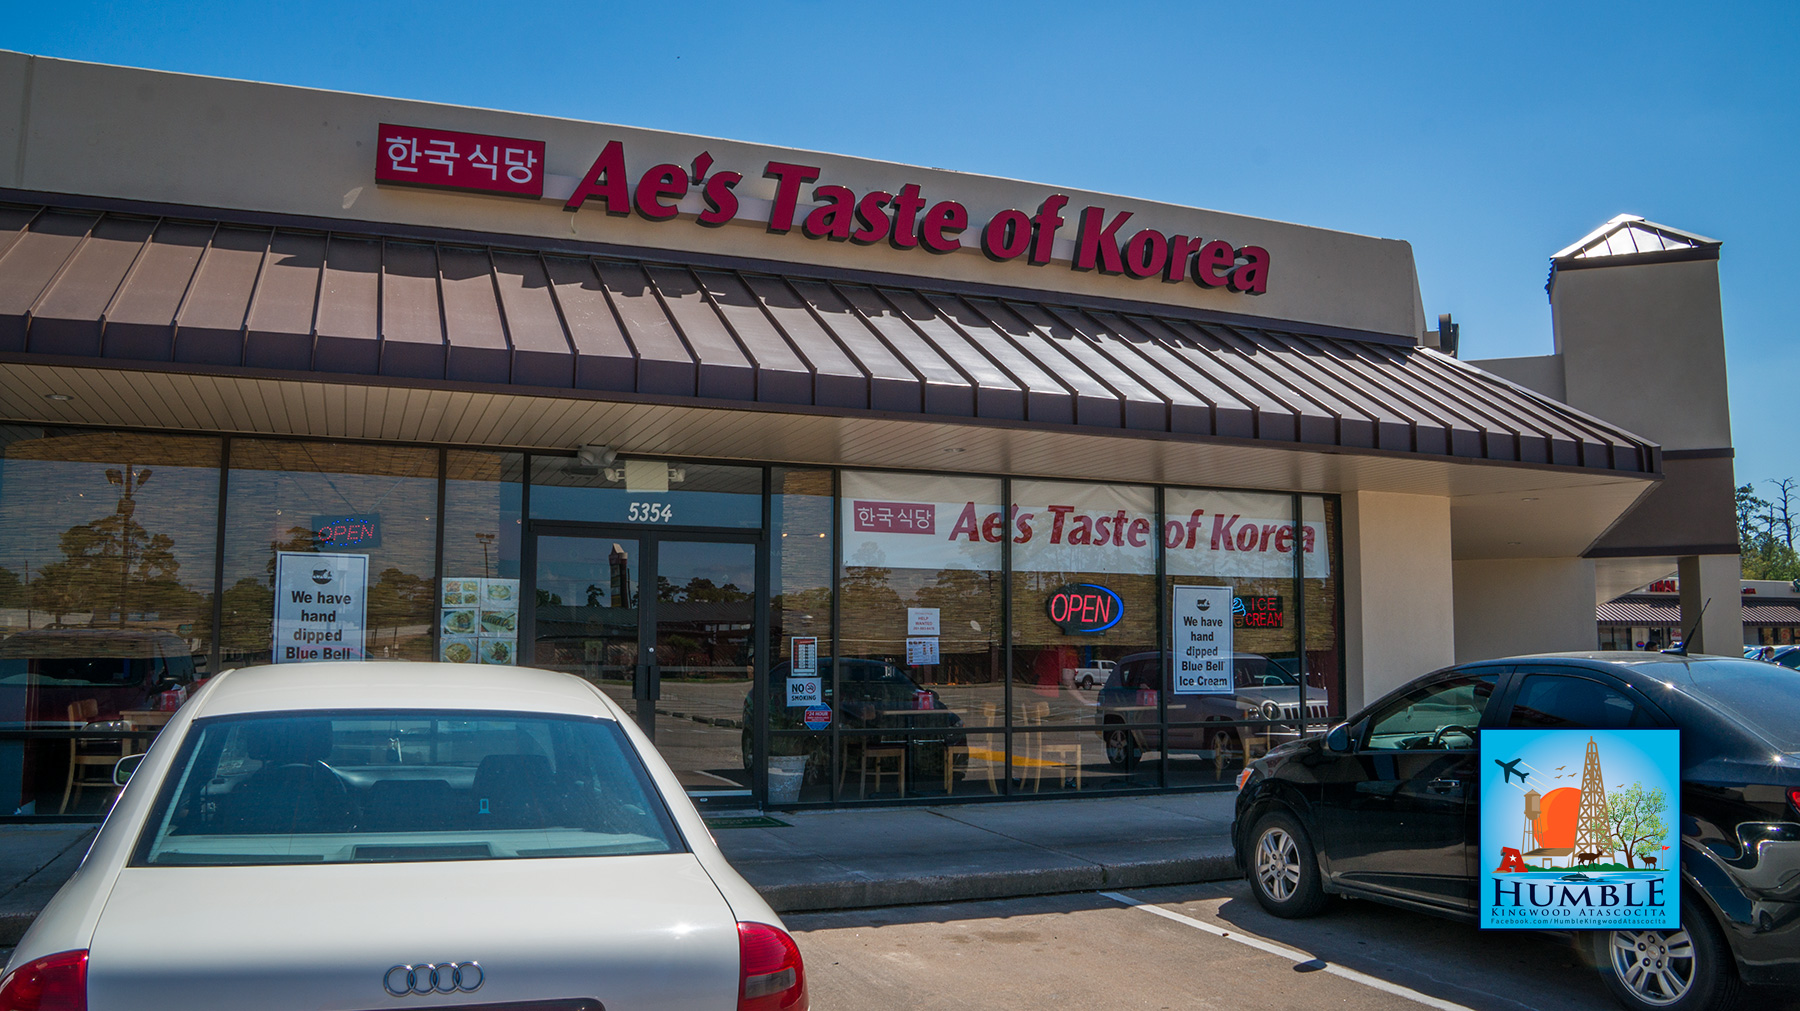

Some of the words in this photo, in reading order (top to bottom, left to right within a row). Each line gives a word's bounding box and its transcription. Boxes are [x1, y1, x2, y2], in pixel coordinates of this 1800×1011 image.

[563, 140, 743, 228] Ae's
[763, 161, 968, 254] Taste
[981, 193, 1069, 267] of
[1072, 205, 1270, 295] Korea
[628, 502, 673, 523] 5354
[318, 524, 375, 542] OPEN
[948, 501, 1035, 544] Ae's
[1047, 505, 1150, 547] Taste
[1165, 509, 1205, 550] of
[1210, 514, 1316, 553] Korea
[291, 591, 312, 604] We
[317, 592, 352, 605] have
[1251, 598, 1277, 611] ICE
[1051, 593, 1111, 623] OPEN
[301, 610, 336, 622] hand
[1183, 616, 1198, 627] We
[1201, 617, 1223, 627] have
[1245, 612, 1283, 627] CREAM
[293, 628, 342, 644] dipped
[1190, 632, 1214, 641] hand
[286, 647, 318, 660] Blue
[323, 648, 350, 660] Bell
[1186, 646, 1218, 658] dipped
[1182, 661, 1203, 671] Blue
[1206, 661, 1224, 671] Bell
[1179, 676, 1195, 686] Ice
[1197, 676, 1228, 686] Cream
[791, 684, 805, 693] NO
